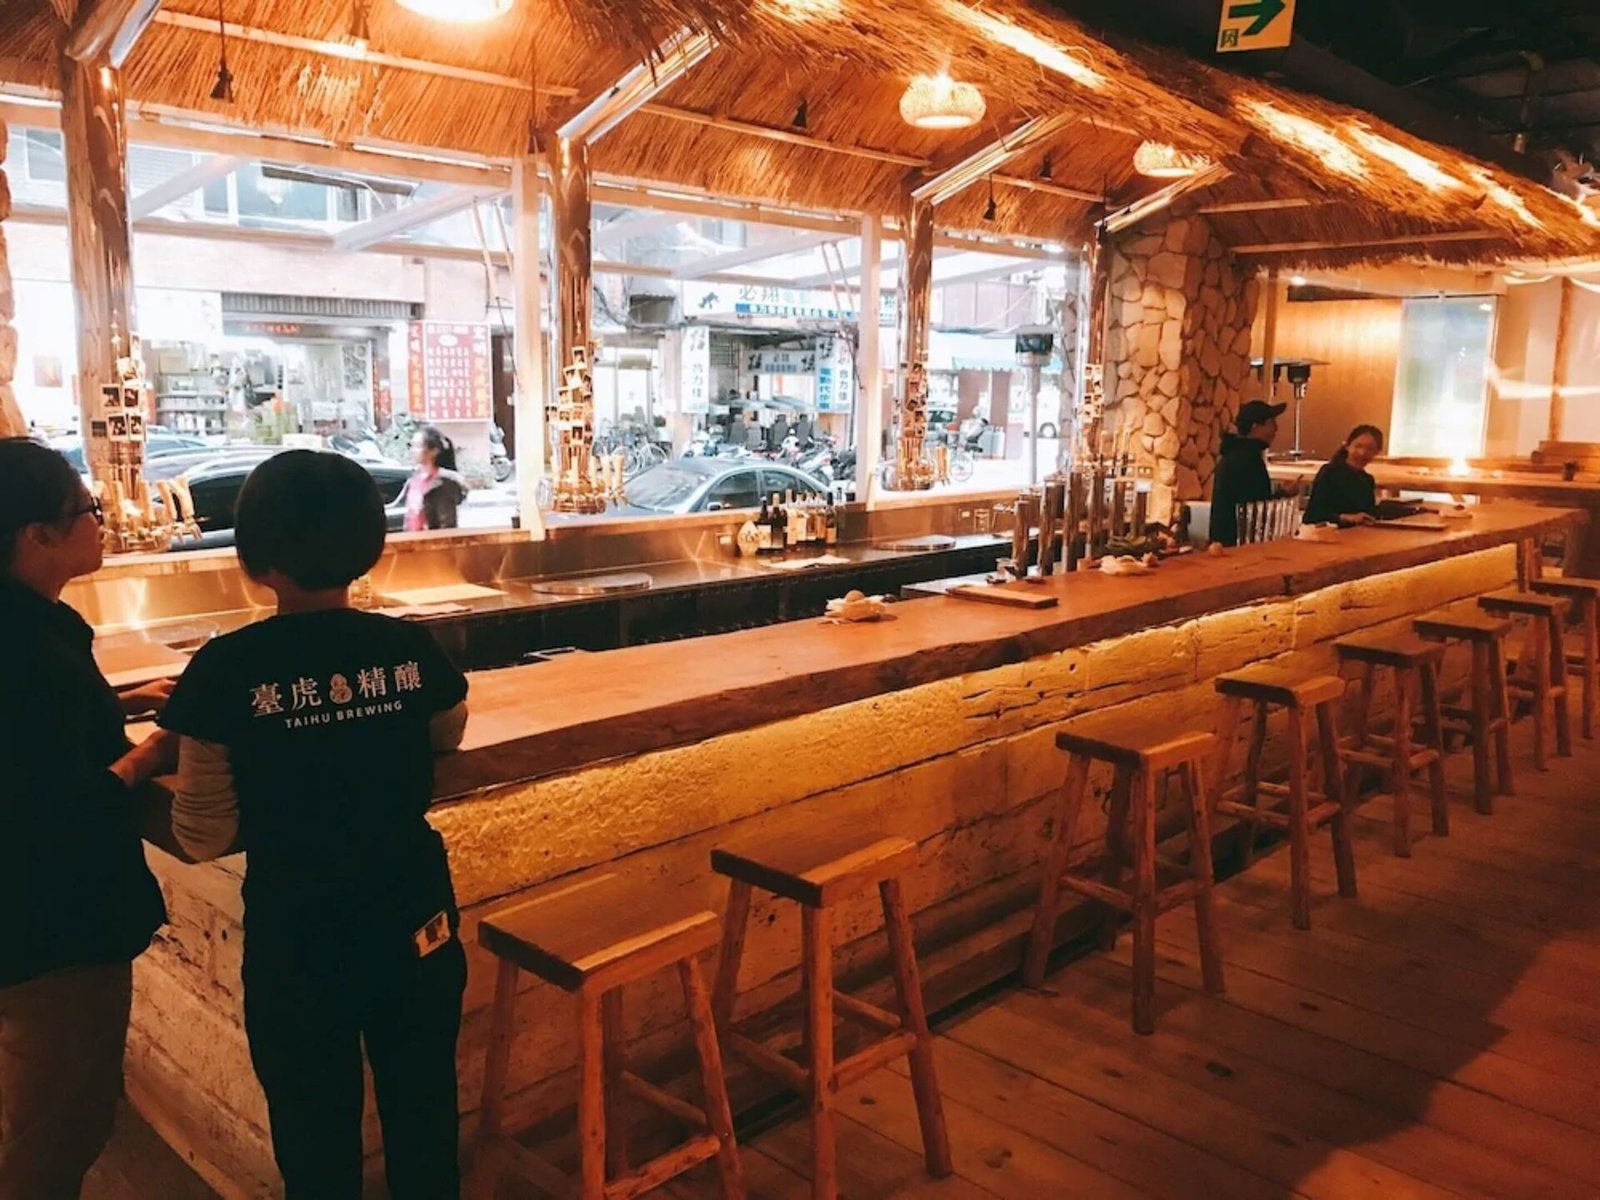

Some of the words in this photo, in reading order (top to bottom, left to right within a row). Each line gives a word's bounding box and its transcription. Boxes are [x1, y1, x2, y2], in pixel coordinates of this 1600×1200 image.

[250, 677, 322, 717] 臺虎
[357, 660, 422, 698] 精釀
[284, 713, 330, 728] TAIHU
[336, 701, 403, 721] BREWING
